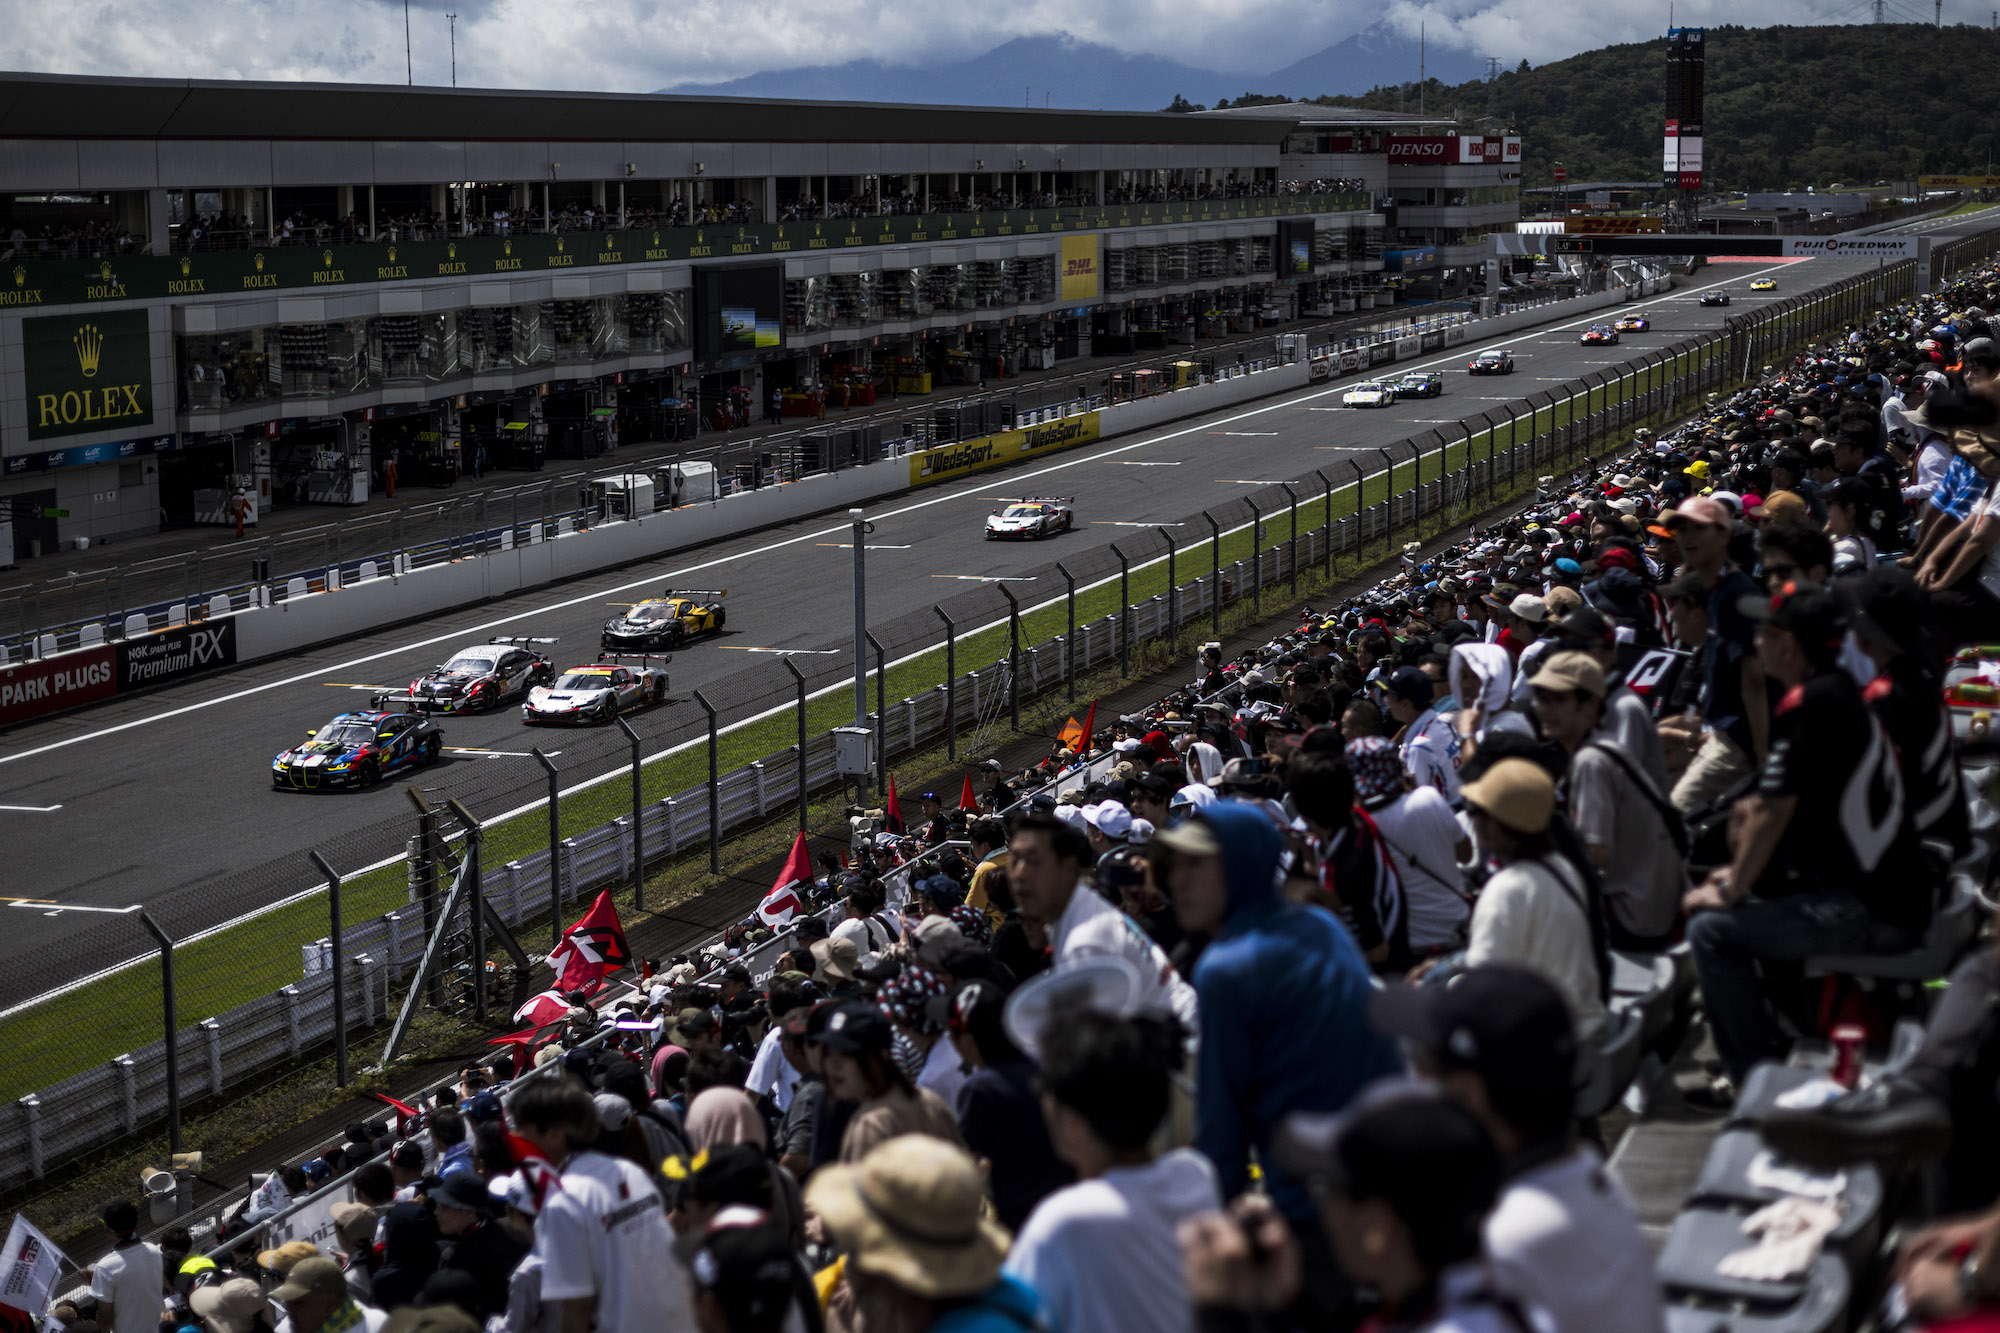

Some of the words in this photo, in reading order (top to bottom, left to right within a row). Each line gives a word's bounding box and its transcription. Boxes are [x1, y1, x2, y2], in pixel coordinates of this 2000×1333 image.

[1390, 143, 1444, 156] DENSO
[1469, 143, 1483, 156] DENSO
[1485, 143, 1500, 156] DENSO
[1506, 143, 1520, 156] DENSO
[1580, 219, 1641, 234] DHL
[772, 241, 790, 250] ROLEX
[809, 238, 827, 248] ROLEX
[845, 236, 862, 245] ROLEX
[1556, 242, 1571, 250] LAP
[1826, 239, 1906, 250] SPEEDWAY
[646, 248, 668, 260] ROLEX
[690, 246, 711, 256] ROLEX
[732, 243, 752, 253] ROLEX
[496, 258, 522, 270] ROLEX
[549, 254, 573, 266] ROLEX
[599, 252, 622, 263] ROLEX
[378, 266, 408, 278] ROLEX
[439, 262, 466, 274] ROLEX
[1066, 258, 1094, 276] DHL
[244, 274, 278, 288] ROLEX
[313, 270, 344, 283] ROLEX
[88, 284, 127, 298] ROLEX
[168, 279, 204, 293] ROLEX
[0, 290, 42, 304] ROLEX
[37, 384, 143, 427] ROLEX
[1030, 419, 1082, 449] WedsSport
[932, 440, 993, 474] WedsSport
[128, 645, 148, 661] NGK
[150, 644, 166, 655] SPARK
[168, 640, 182, 651] PLUG
[128, 654, 188, 683] Premium
[188, 626, 227, 667] RX
[0, 676, 50, 707] PARK
[54, 661, 111, 694] PLUGS
